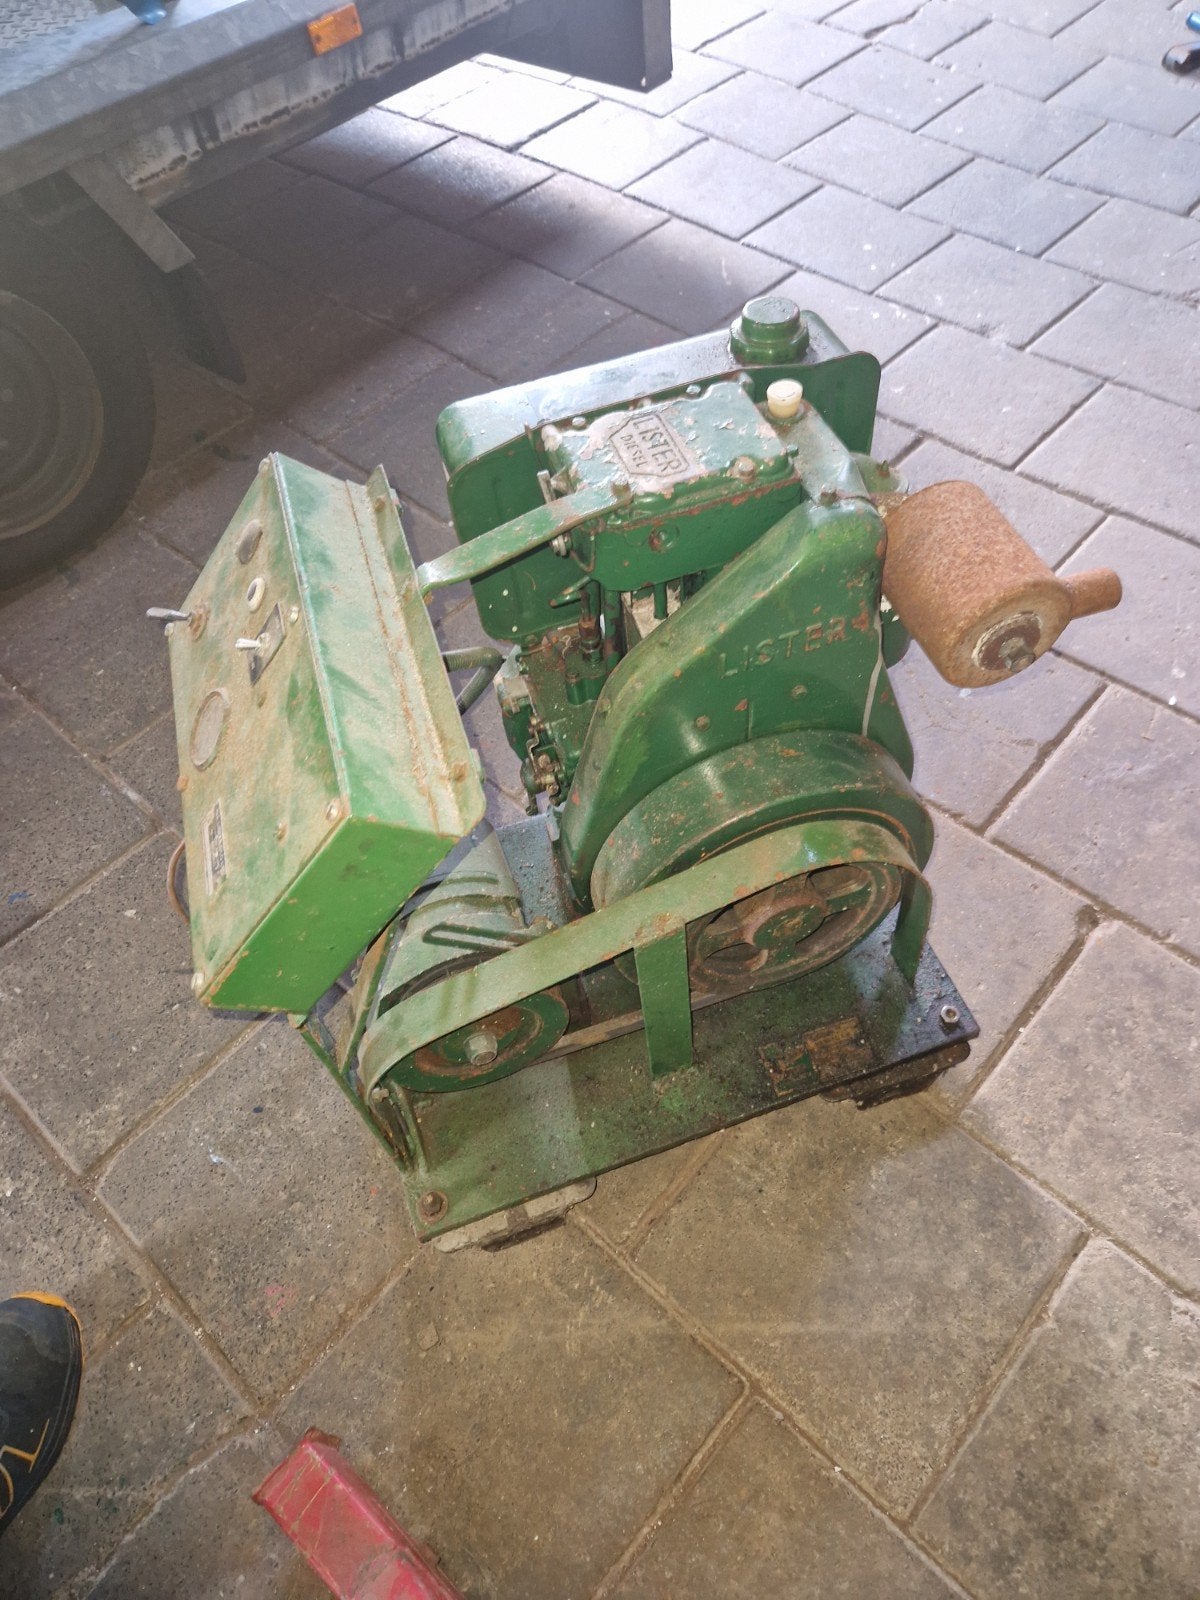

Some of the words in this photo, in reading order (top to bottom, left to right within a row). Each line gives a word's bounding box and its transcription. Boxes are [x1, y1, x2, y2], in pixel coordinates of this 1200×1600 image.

[621, 435, 649, 467] DIESEL
[632, 416, 683, 473] LISTER
[719, 616, 847, 679] LISTER
